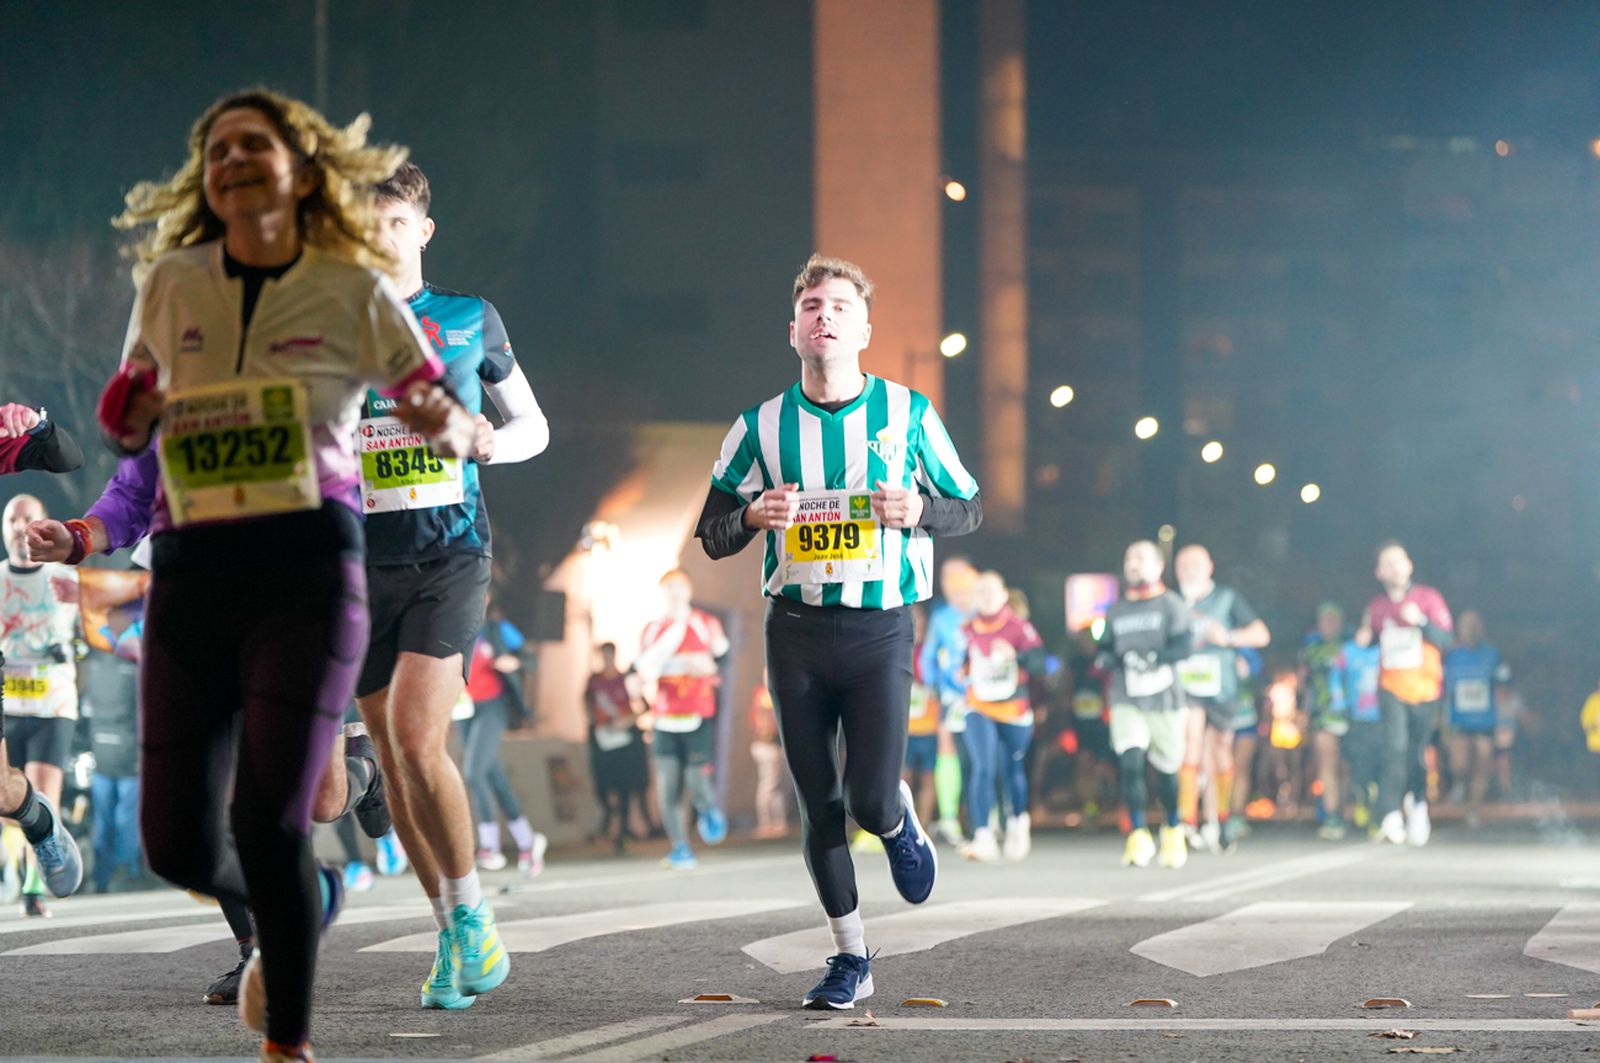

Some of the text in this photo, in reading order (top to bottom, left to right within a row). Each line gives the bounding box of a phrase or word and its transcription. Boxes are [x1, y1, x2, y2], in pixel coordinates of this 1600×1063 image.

[177, 425, 292, 473] 13252
[366, 438, 386, 451] SAN
[376, 449, 443, 479] 8345
[798, 500, 840, 511] NOCHE DE
[793, 512, 807, 523] AN
[798, 523, 860, 552] 9379
